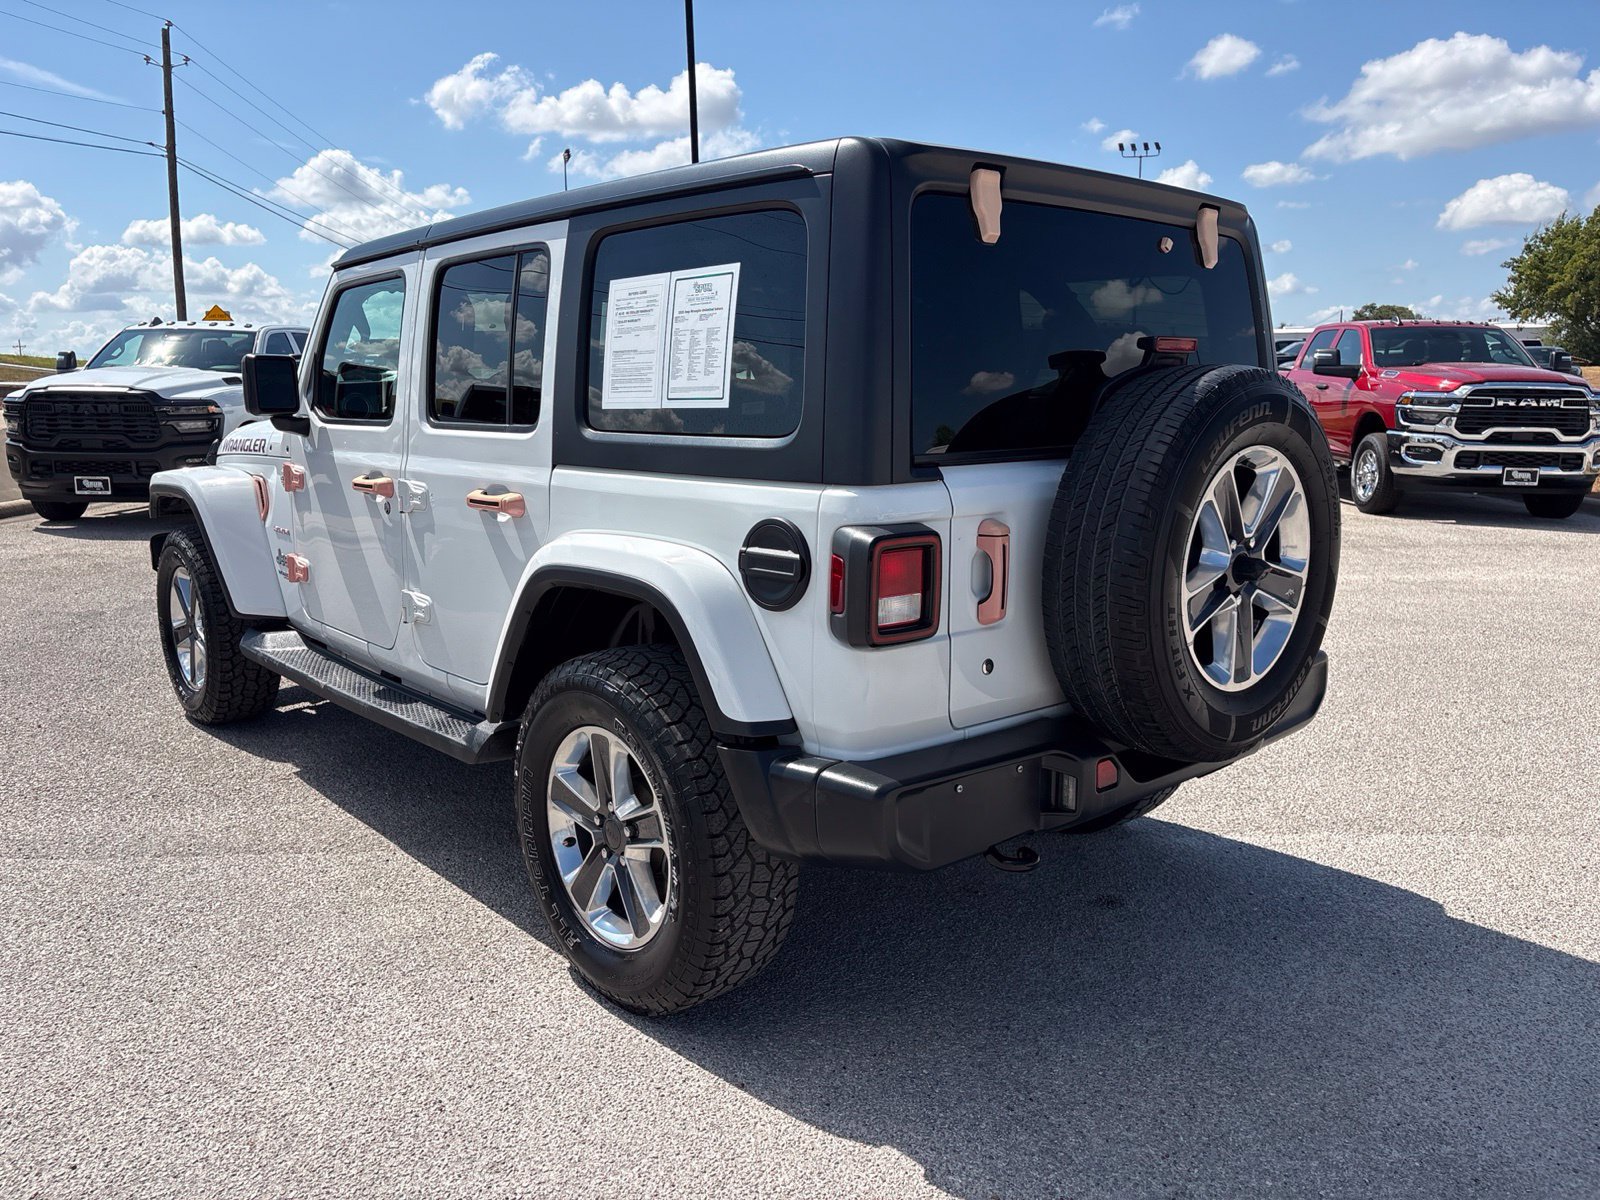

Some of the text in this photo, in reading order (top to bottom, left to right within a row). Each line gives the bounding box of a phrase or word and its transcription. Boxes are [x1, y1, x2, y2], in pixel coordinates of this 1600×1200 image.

[55, 403, 120, 415] RAM
[1497, 398, 1560, 407] RAM
[222, 438, 266, 453] WRANGLER
[521, 765, 581, 950] ALL TERRAIN
